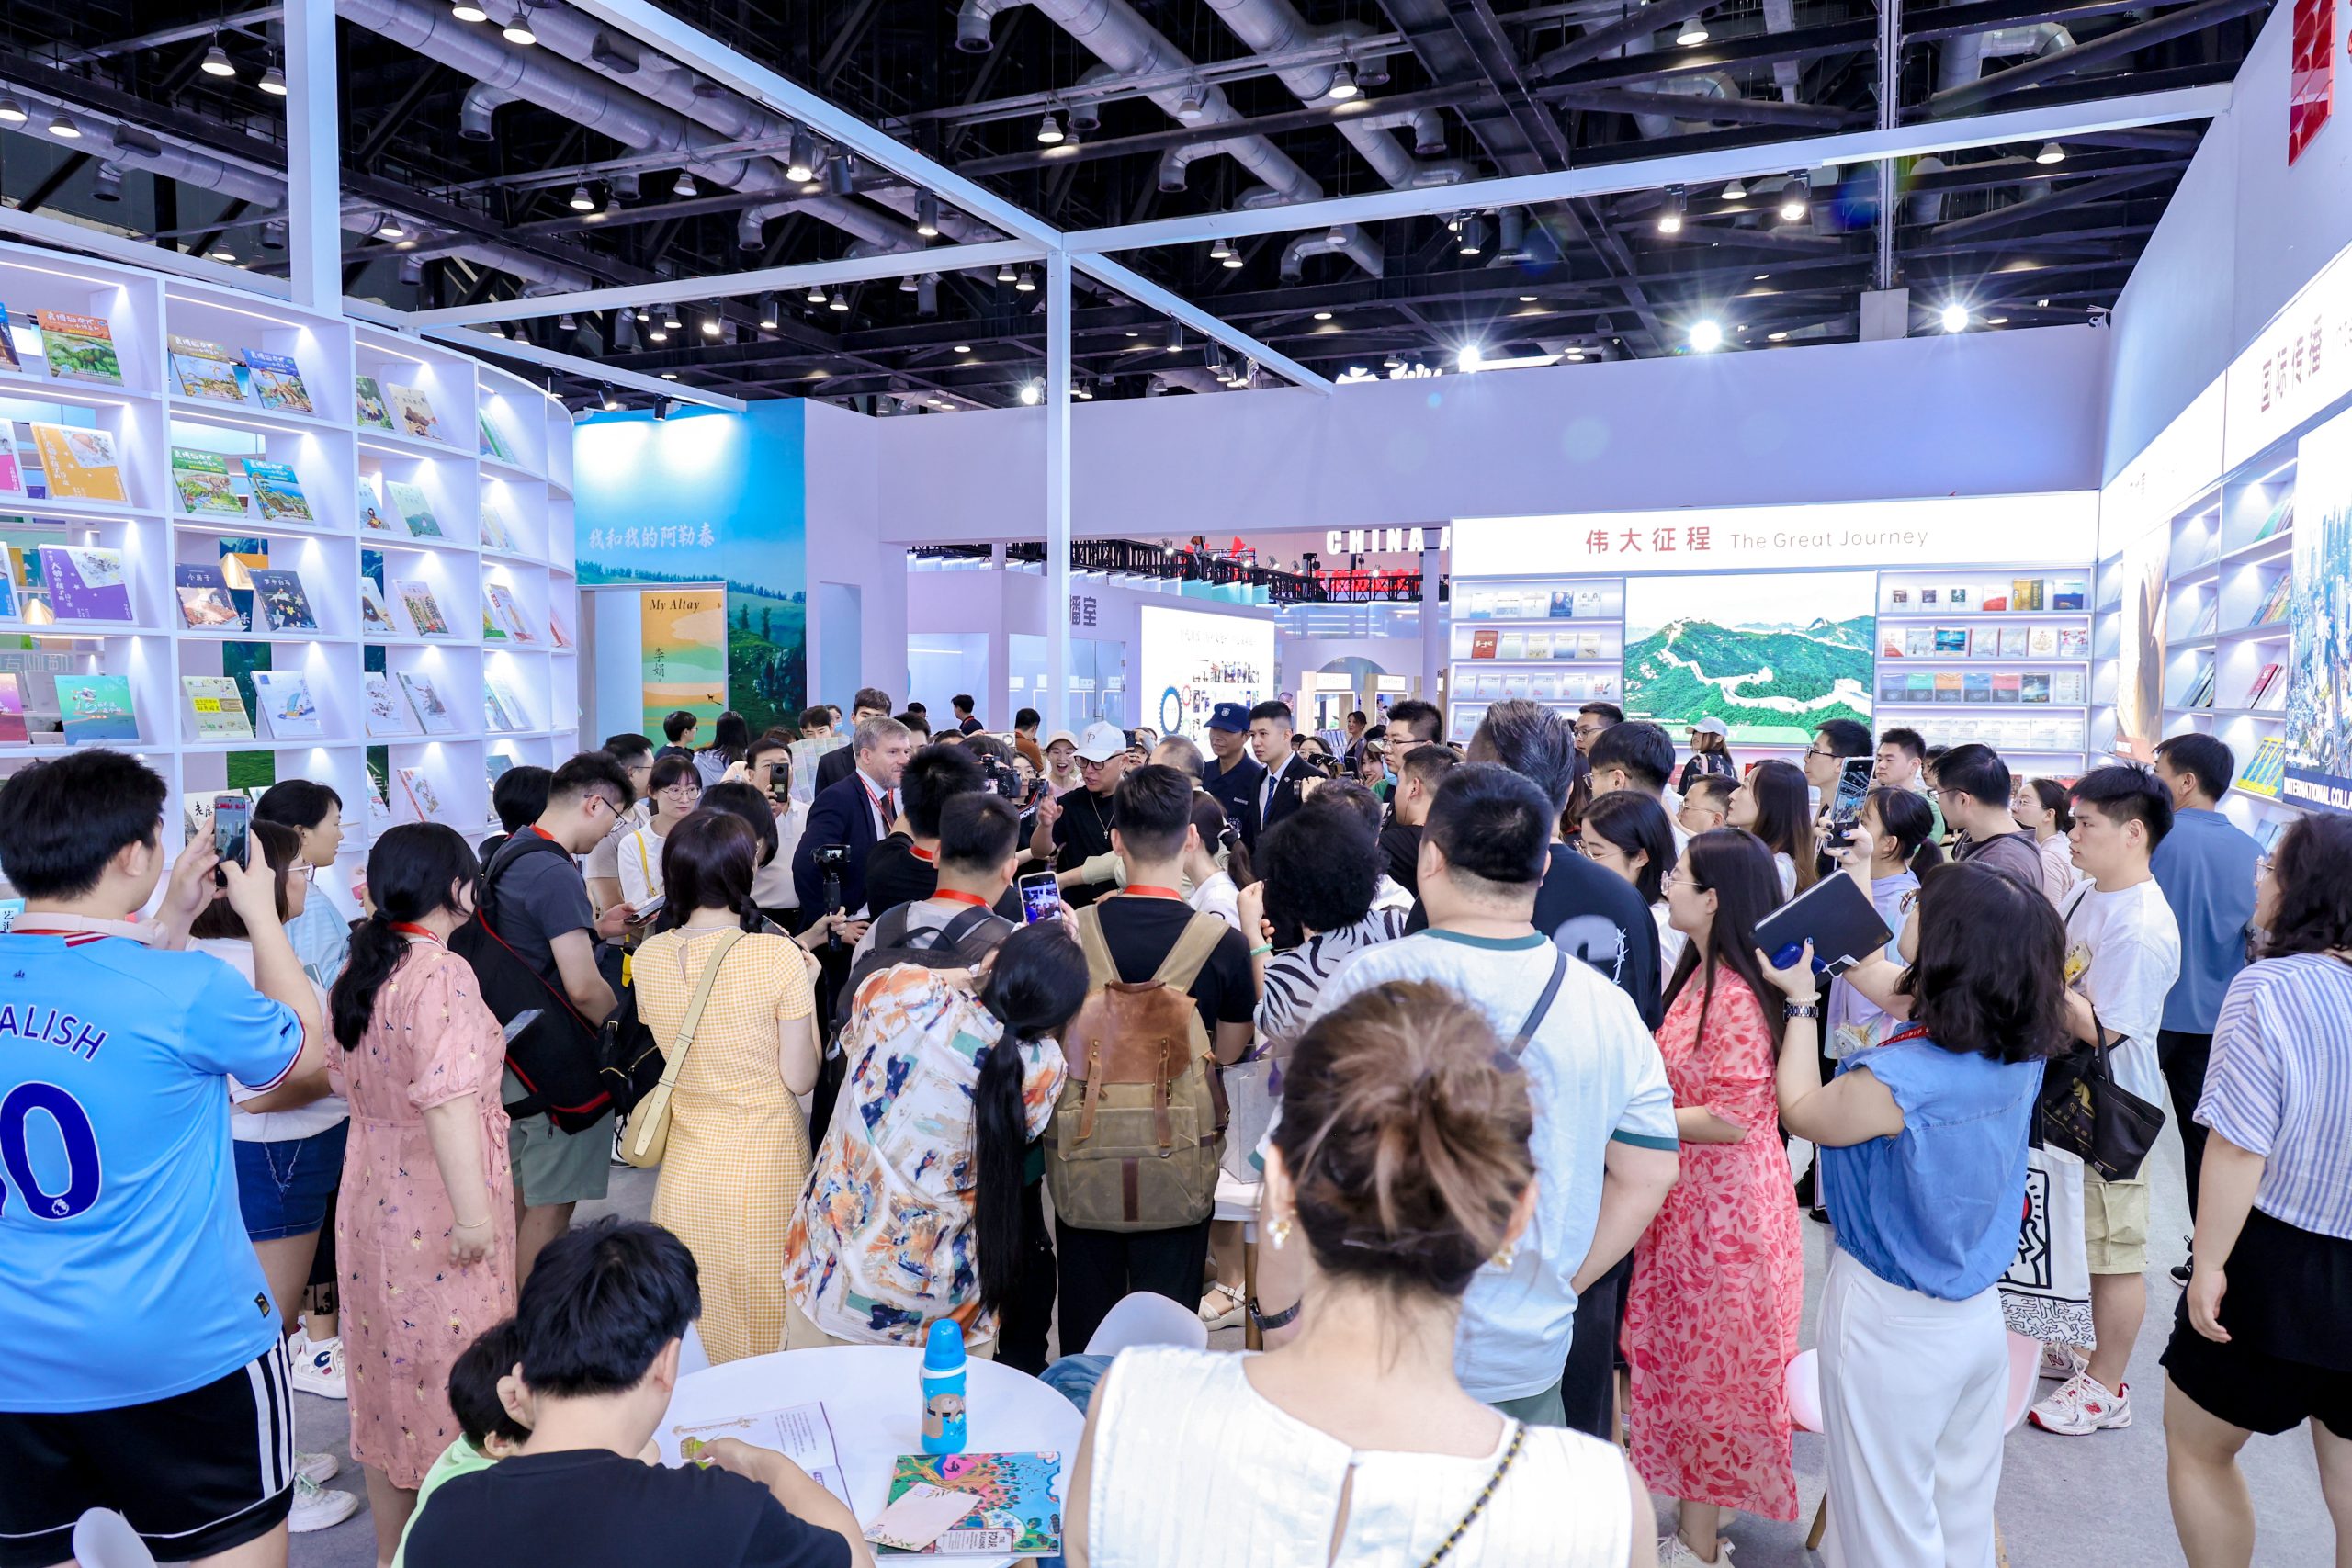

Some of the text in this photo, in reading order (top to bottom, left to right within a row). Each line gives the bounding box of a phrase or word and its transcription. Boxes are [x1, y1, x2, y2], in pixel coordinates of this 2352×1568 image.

[2261, 313, 2322, 413] 国际传播
[589, 521, 715, 550] 我和我的阿勒泰
[1326, 526, 1425, 555] CHINA
[1586, 526, 1928, 554] 伟大征程 The Great Journey
[650, 597, 700, 615] My Altay
[652, 647, 665, 678] 李娟
[2283, 776, 2332, 806] INTERNATIONAL
[0, 1081, 102, 1221] 0
[988, 1531, 998, 1550] FOUR
